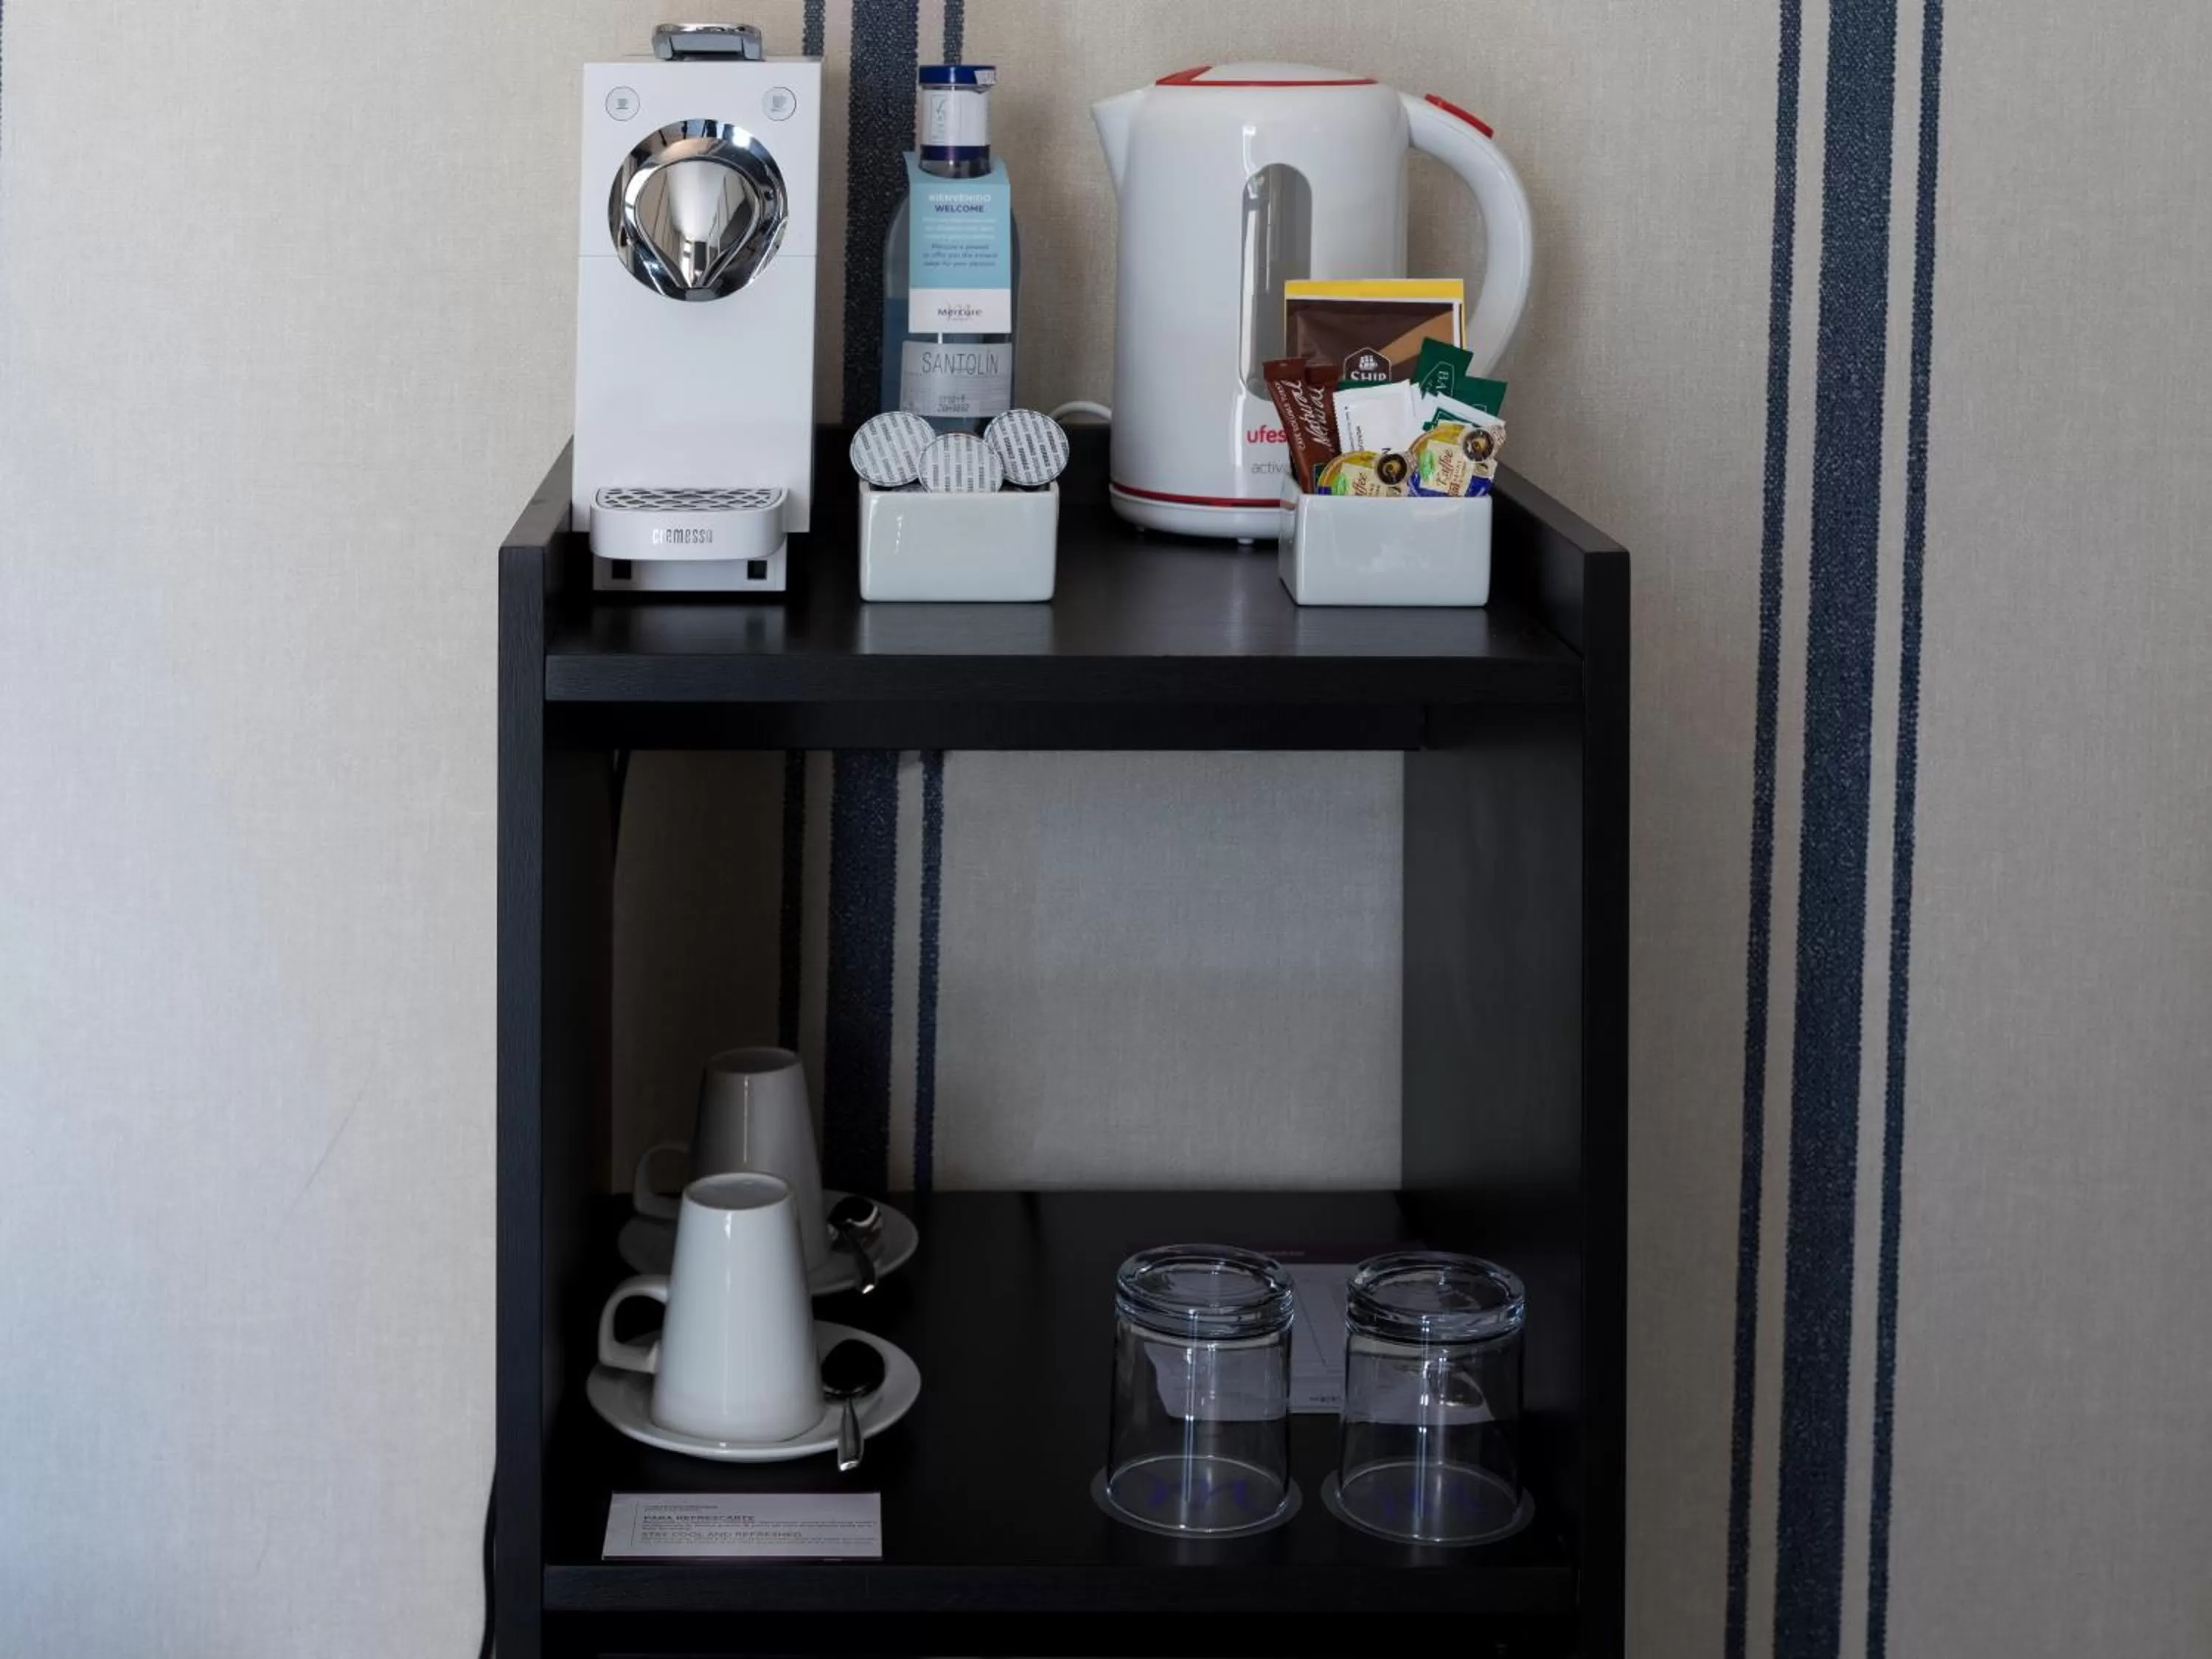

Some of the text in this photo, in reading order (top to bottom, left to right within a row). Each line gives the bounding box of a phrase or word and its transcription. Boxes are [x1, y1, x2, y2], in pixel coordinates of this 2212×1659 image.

[934, 204, 986, 213] WELCOME
[1246, 424, 1287, 444] ufes
[1251, 461, 1285, 474] activ
